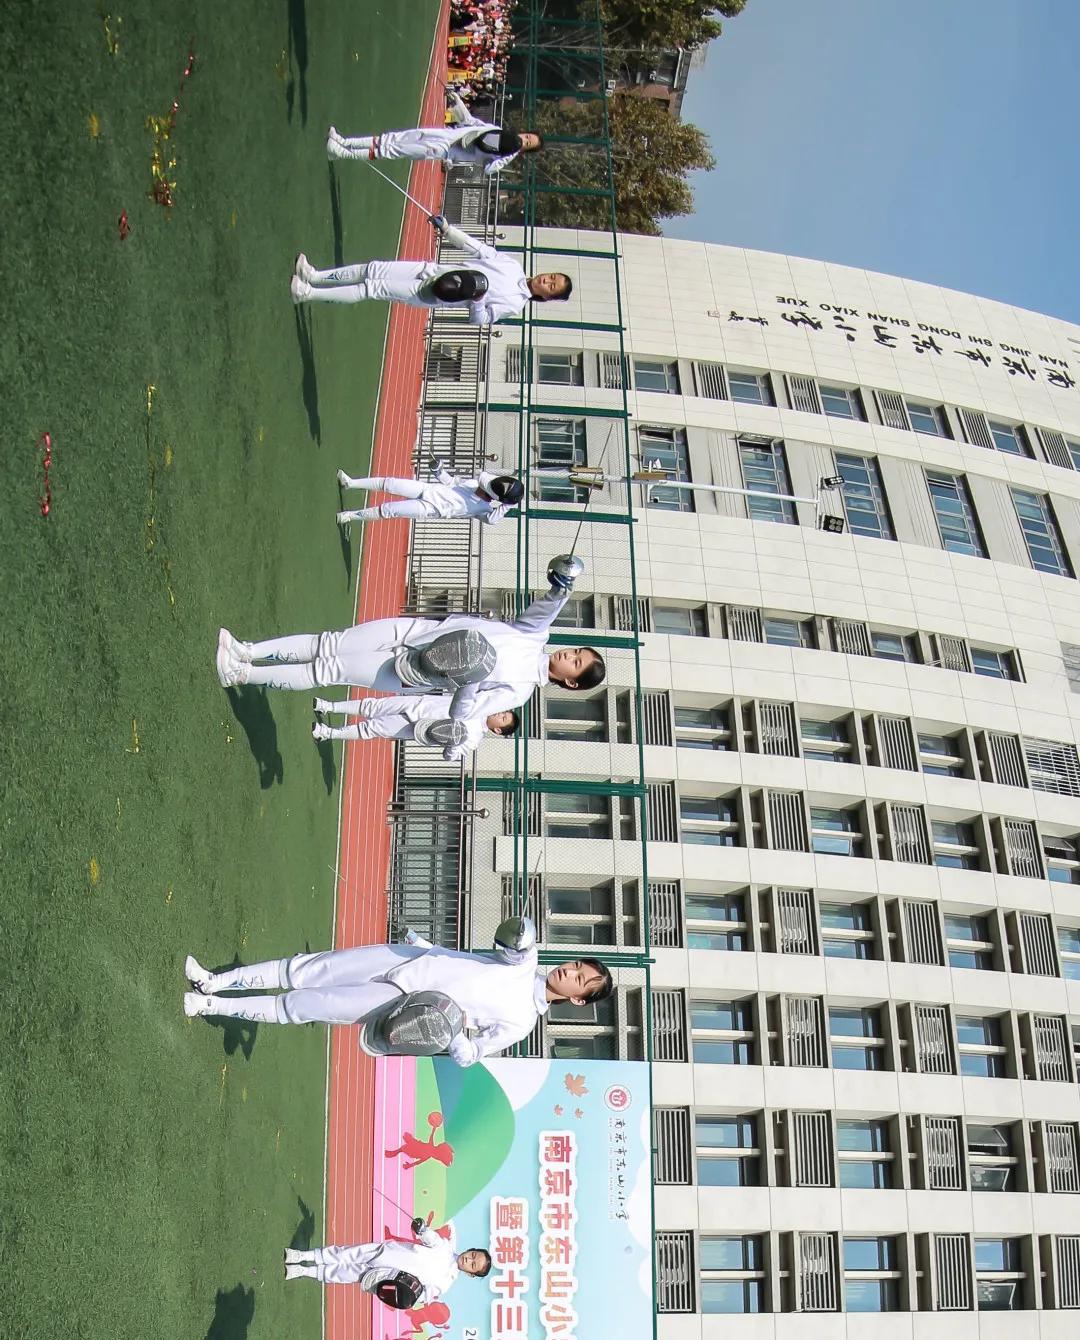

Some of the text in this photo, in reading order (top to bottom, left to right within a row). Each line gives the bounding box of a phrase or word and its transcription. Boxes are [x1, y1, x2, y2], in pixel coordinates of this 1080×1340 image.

[776, 296, 1068, 368] NAN JING SHI DONG SHAN XIAO XUE
[781, 312, 1075, 388] 南京市东山小学
